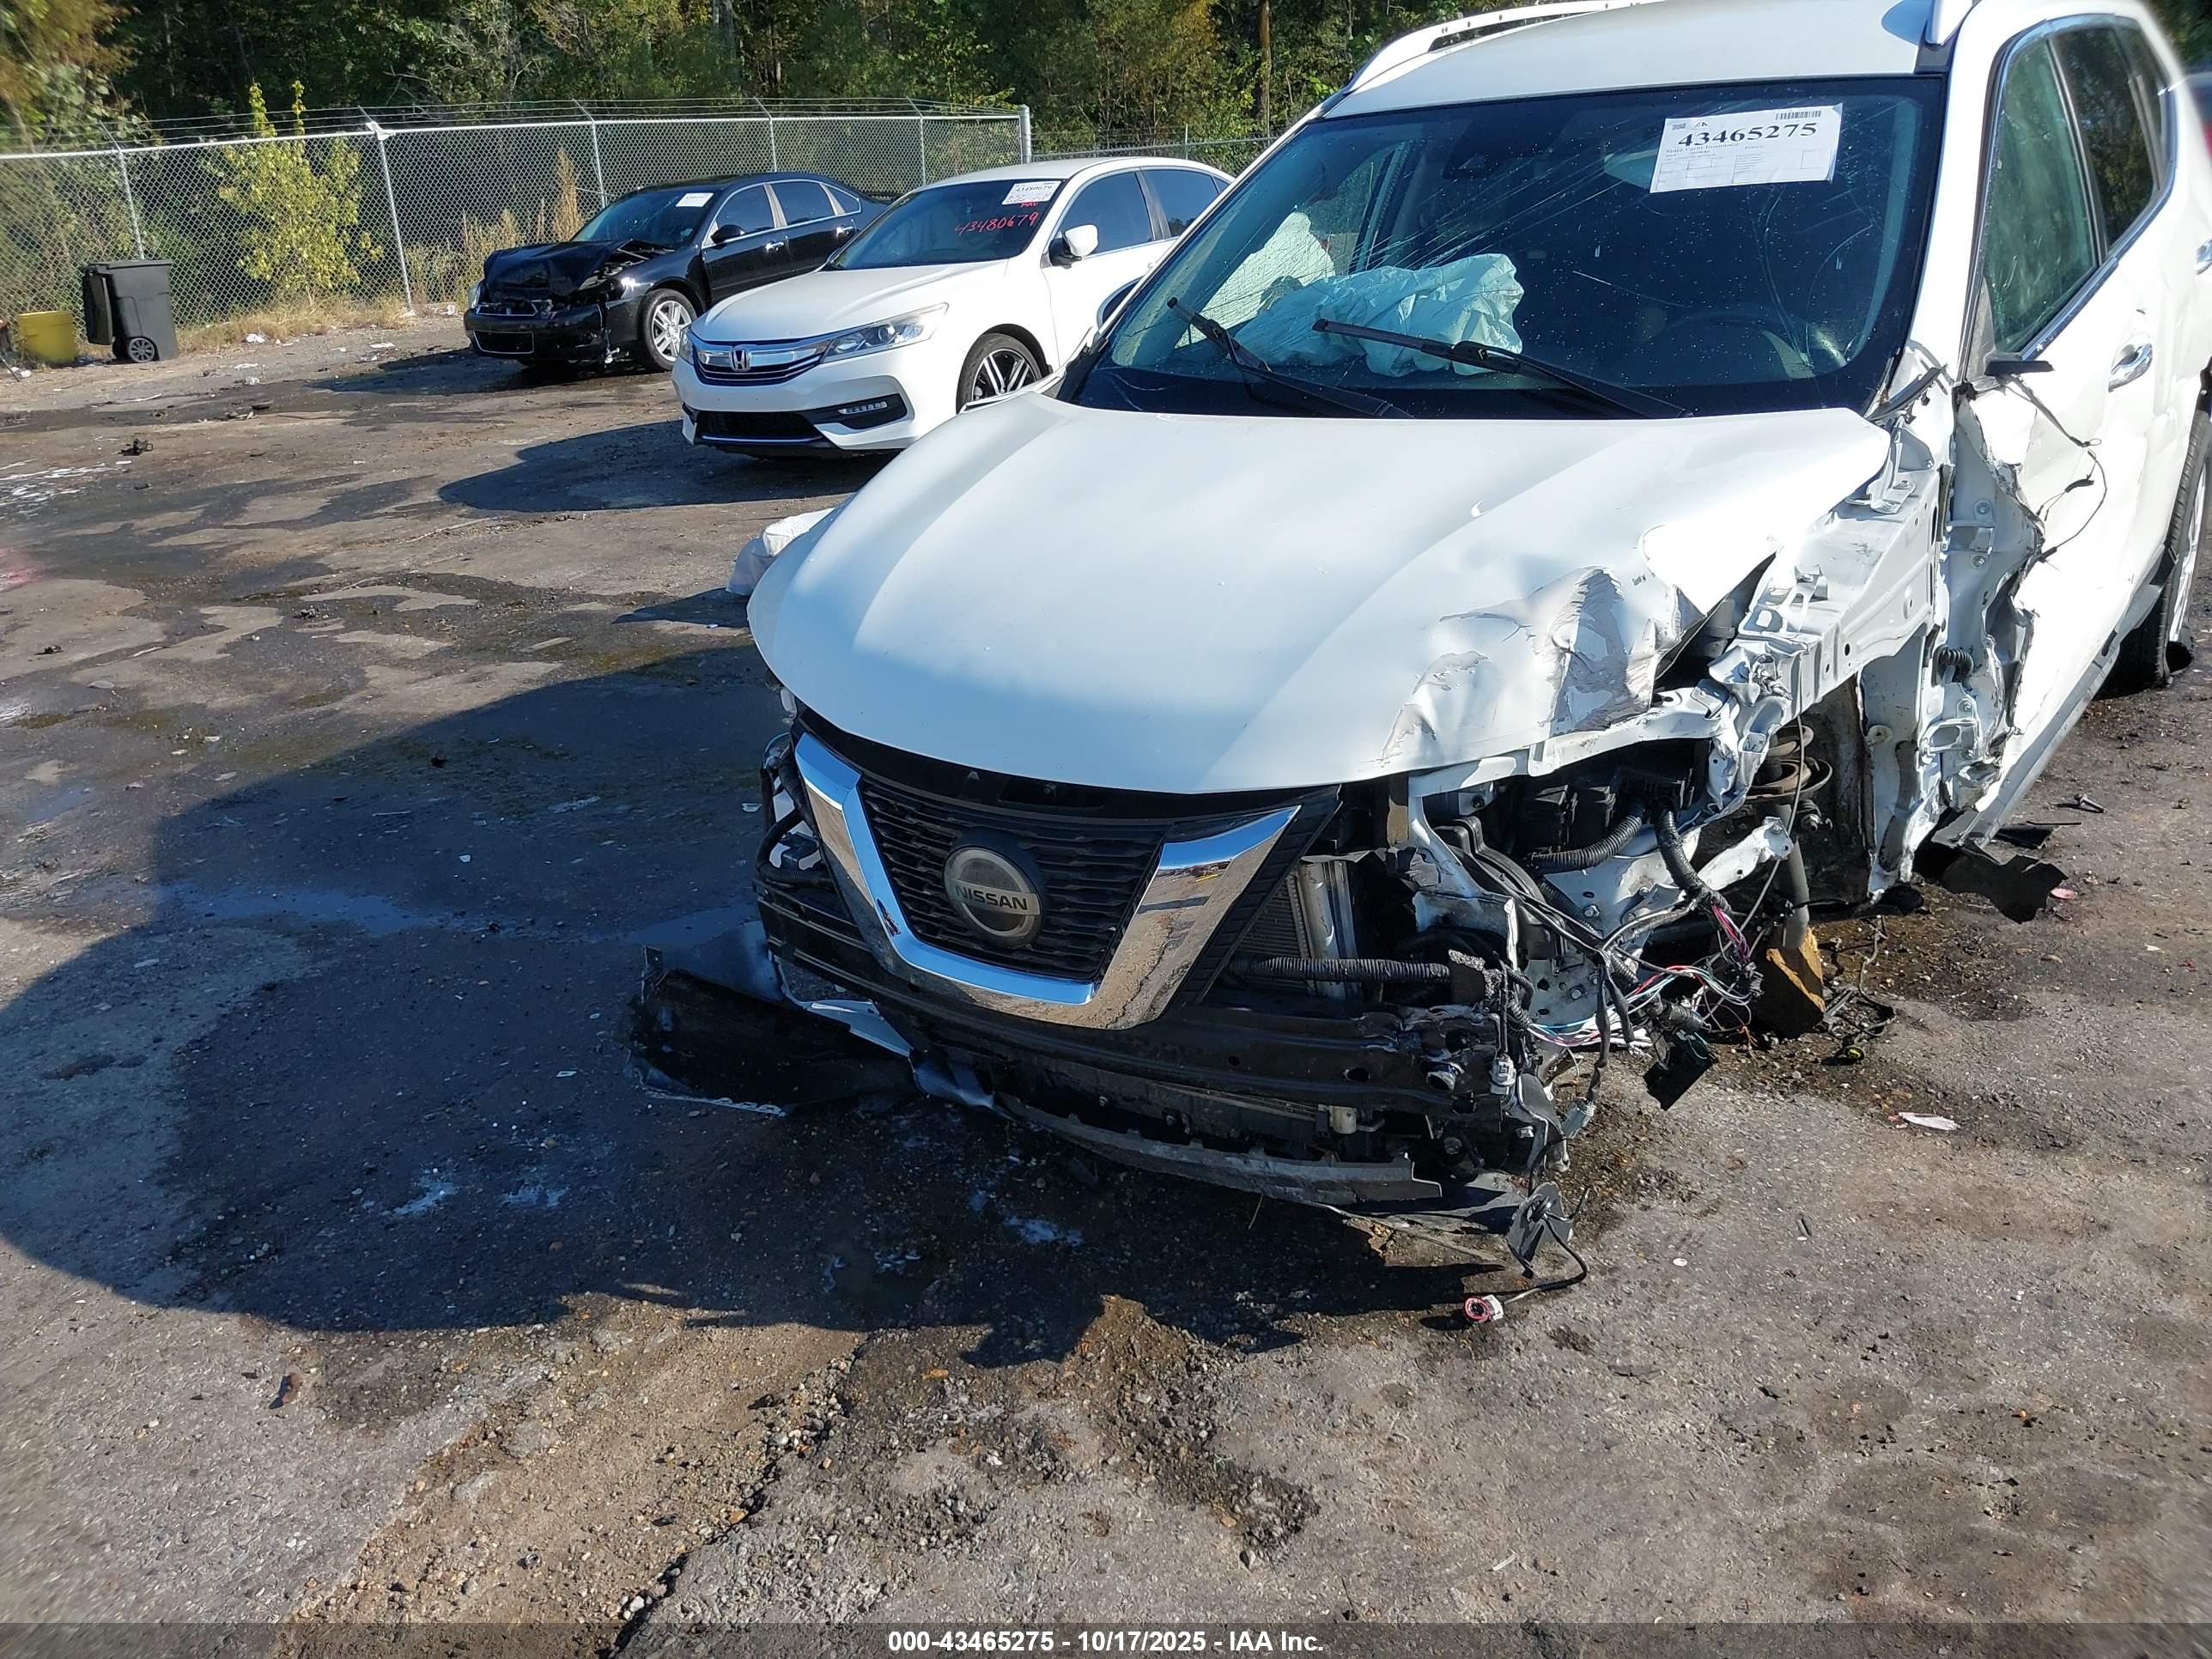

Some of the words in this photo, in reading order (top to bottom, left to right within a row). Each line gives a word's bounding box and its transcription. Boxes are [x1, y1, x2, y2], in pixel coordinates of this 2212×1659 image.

[1678, 122, 1818, 147] 43465275
[955, 211, 1038, 236] 43480679
[955, 884, 1028, 910] NISSAN
